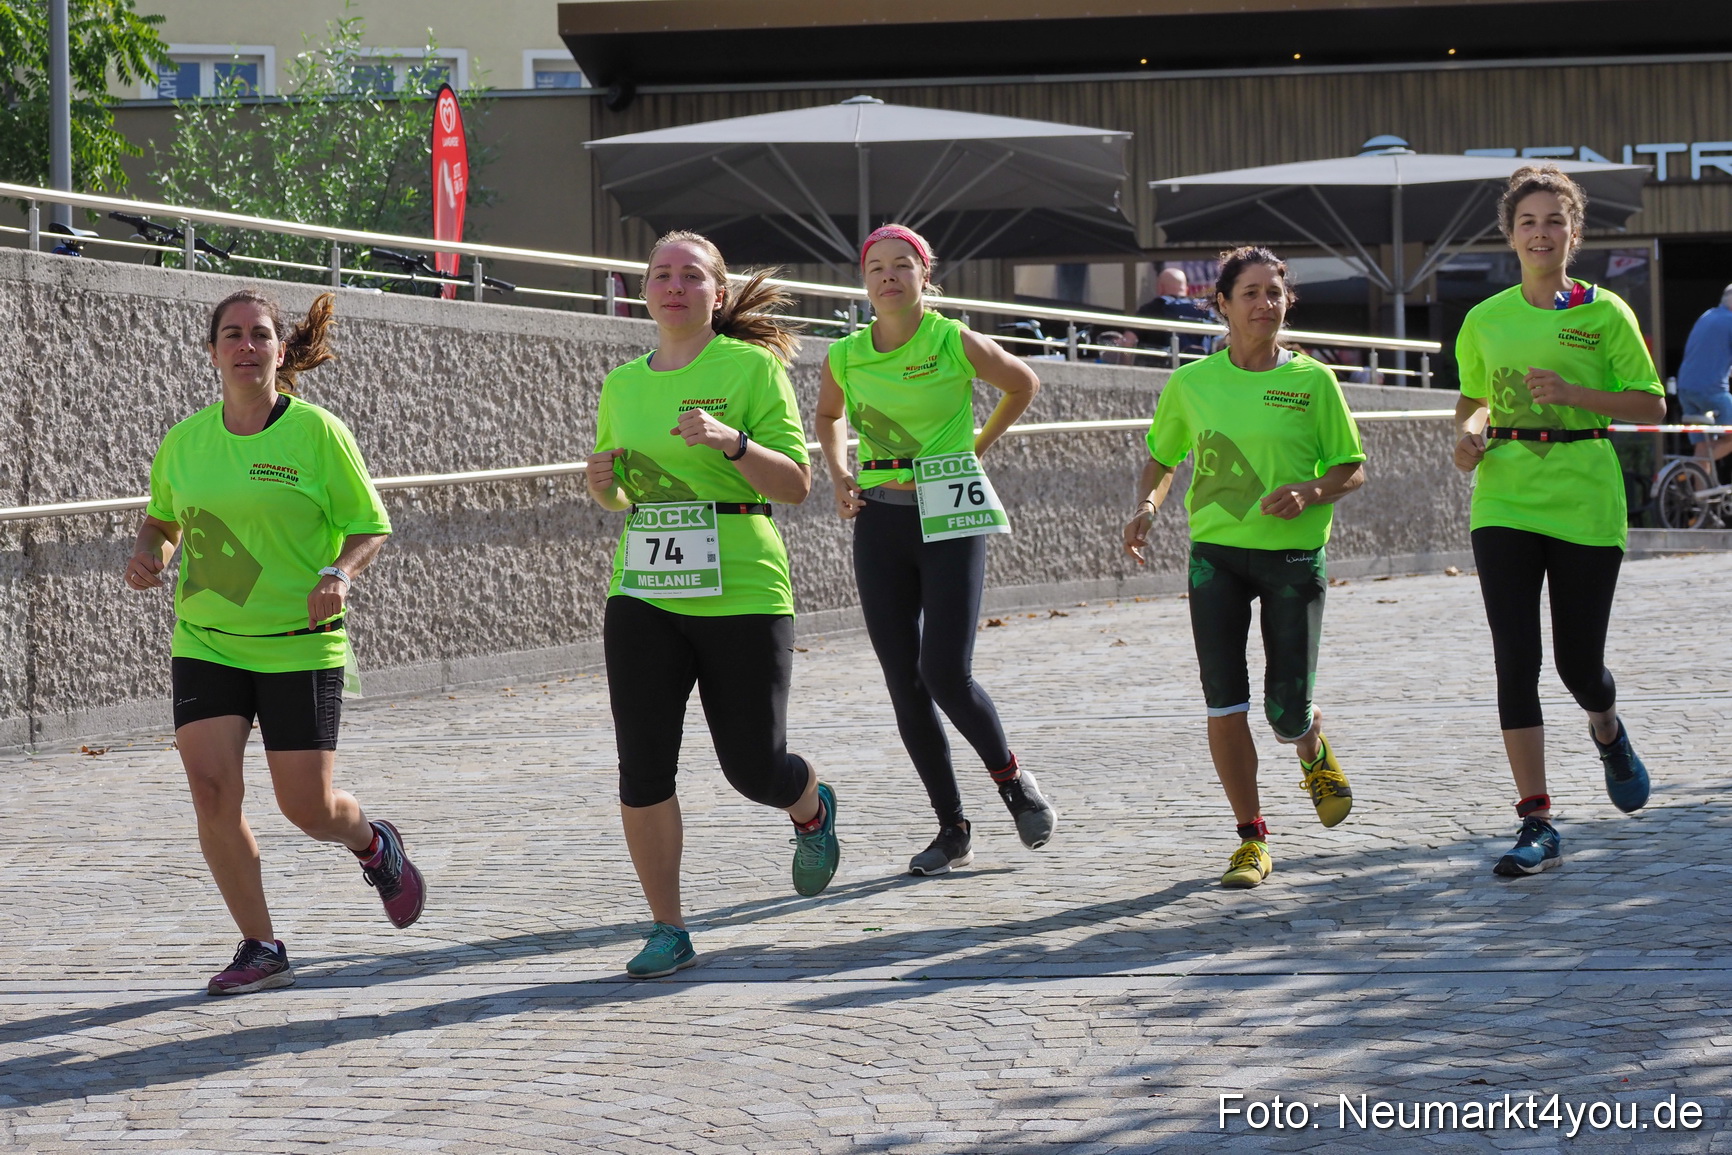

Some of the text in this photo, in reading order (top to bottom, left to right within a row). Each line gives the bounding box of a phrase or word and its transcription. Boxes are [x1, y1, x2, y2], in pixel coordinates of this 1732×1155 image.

[1263, 395, 1310, 407] ELEMENTELAUF
[1266, 389, 1311, 399] NEUMARKTER
[1271, 402, 1296, 410] September
[249, 469, 299, 483] ELEMENTELAUF
[252, 463, 298, 476] NEUMARKTER
[948, 481, 985, 508] 76
[633, 506, 708, 528] BOCK
[947, 513, 994, 529] FENJA
[646, 538, 684, 565] 74
[637, 574, 702, 588] MELANIE
